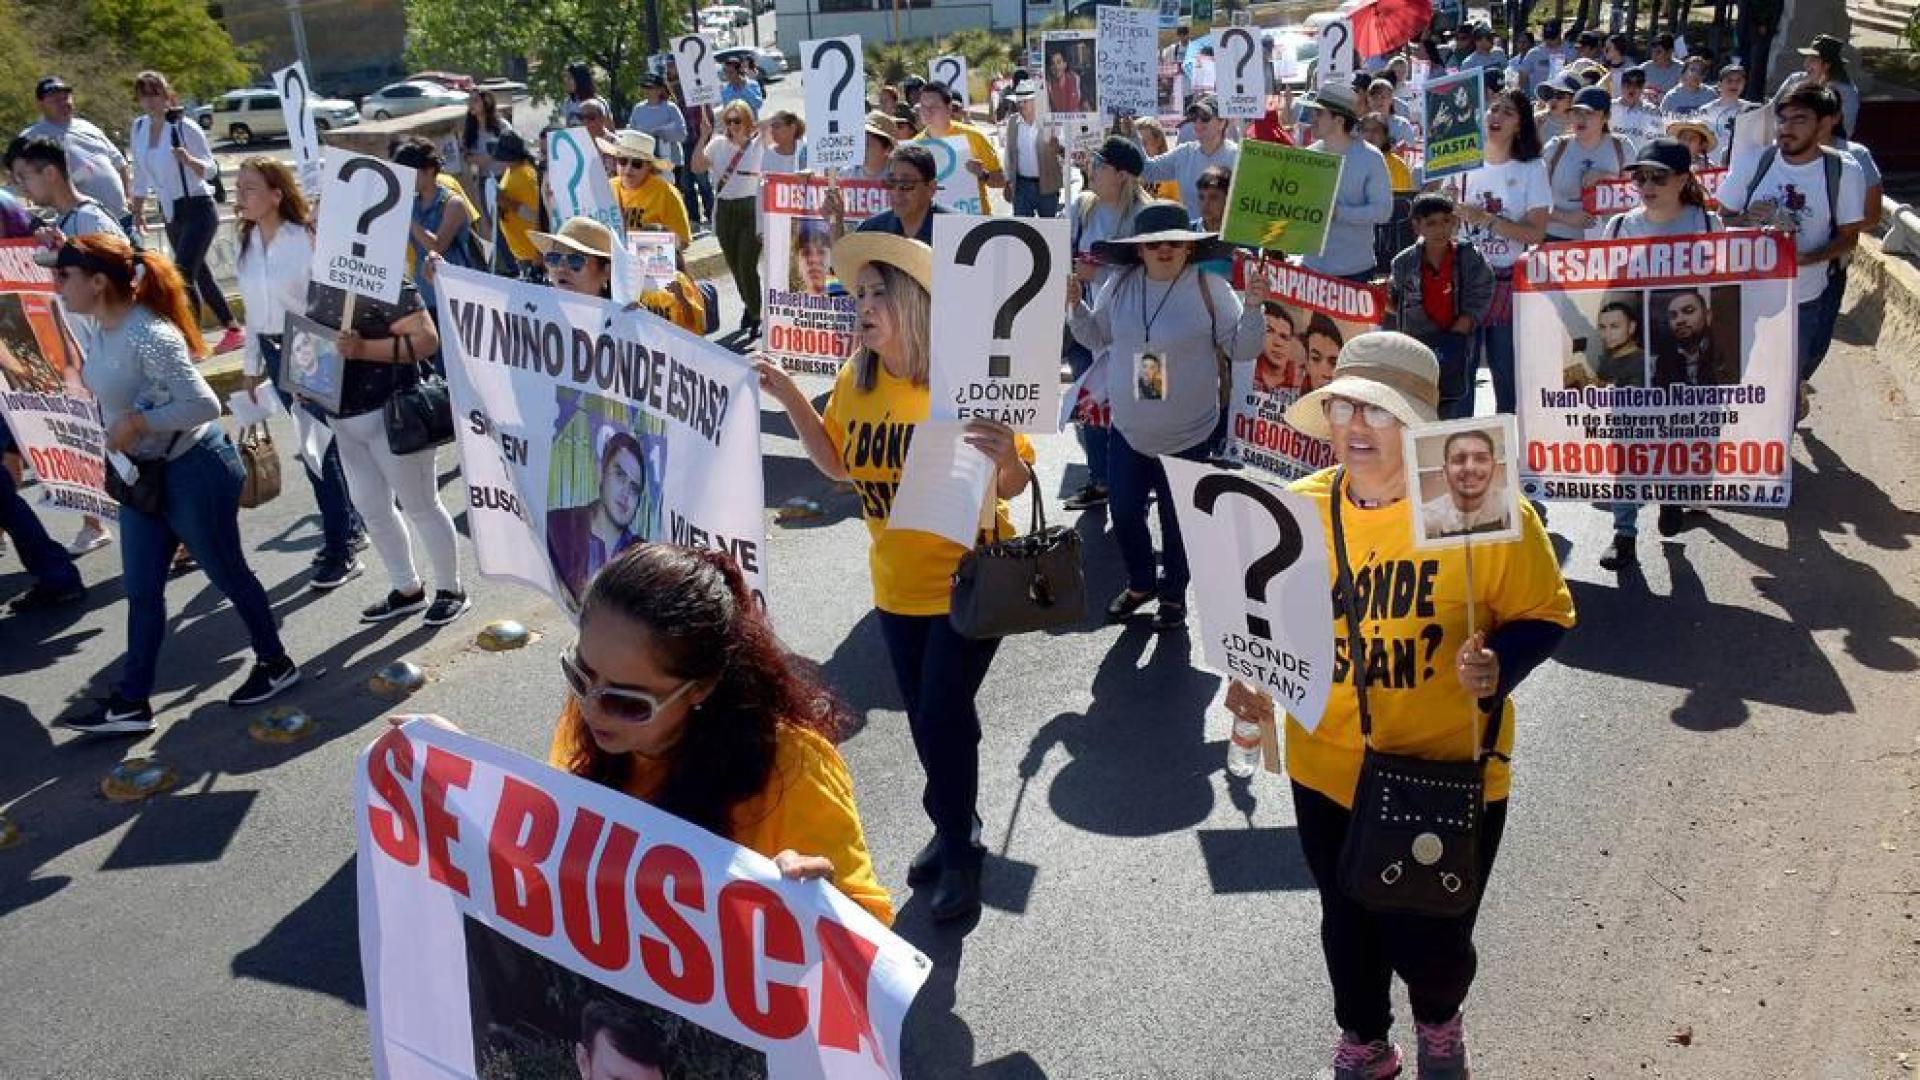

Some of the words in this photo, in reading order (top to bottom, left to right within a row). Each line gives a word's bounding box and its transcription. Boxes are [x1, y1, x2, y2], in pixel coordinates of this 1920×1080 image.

[679, 36, 706, 86] ?
[1220, 28, 1255, 93] ?
[811, 40, 855, 134] ?
[284, 68, 305, 160] ?
[1432, 136, 1476, 158] HASTA
[338, 157, 401, 258] ?
[1240, 197, 1324, 224] SILENCIO
[1269, 177, 1299, 197] NO
[1526, 236, 1778, 284] DESAPARECIDO
[954, 219, 1052, 378] ?
[450, 298, 485, 357] MI
[488, 302, 564, 377] NIÑO
[571, 317, 666, 410] DÓNDE
[955, 379, 1040, 405] ¿DÓNDE
[1541, 387, 1580, 409] Ivan
[1586, 386, 1666, 410] Quintero
[1672, 384, 1766, 406] Navarrete
[1565, 414, 1579, 427] 11
[1582, 413, 1601, 427] de
[1605, 412, 1666, 428] Febrero
[1669, 411, 1695, 426] del
[1699, 410, 1740, 425] 2018
[1585, 425, 1655, 439] Mazatlan
[1658, 424, 1721, 439] Sinaloa
[1527, 441, 1785, 476] 018006703600
[1544, 481, 1637, 501] SABUESOS
[1641, 483, 1750, 502] GUERRERAS
[1193, 473, 1304, 641] ?
[1222, 633, 1311, 681] ¿DÓNDE
[1226, 652, 1307, 707] ESTÁN?
[367, 725, 473, 897] SE
